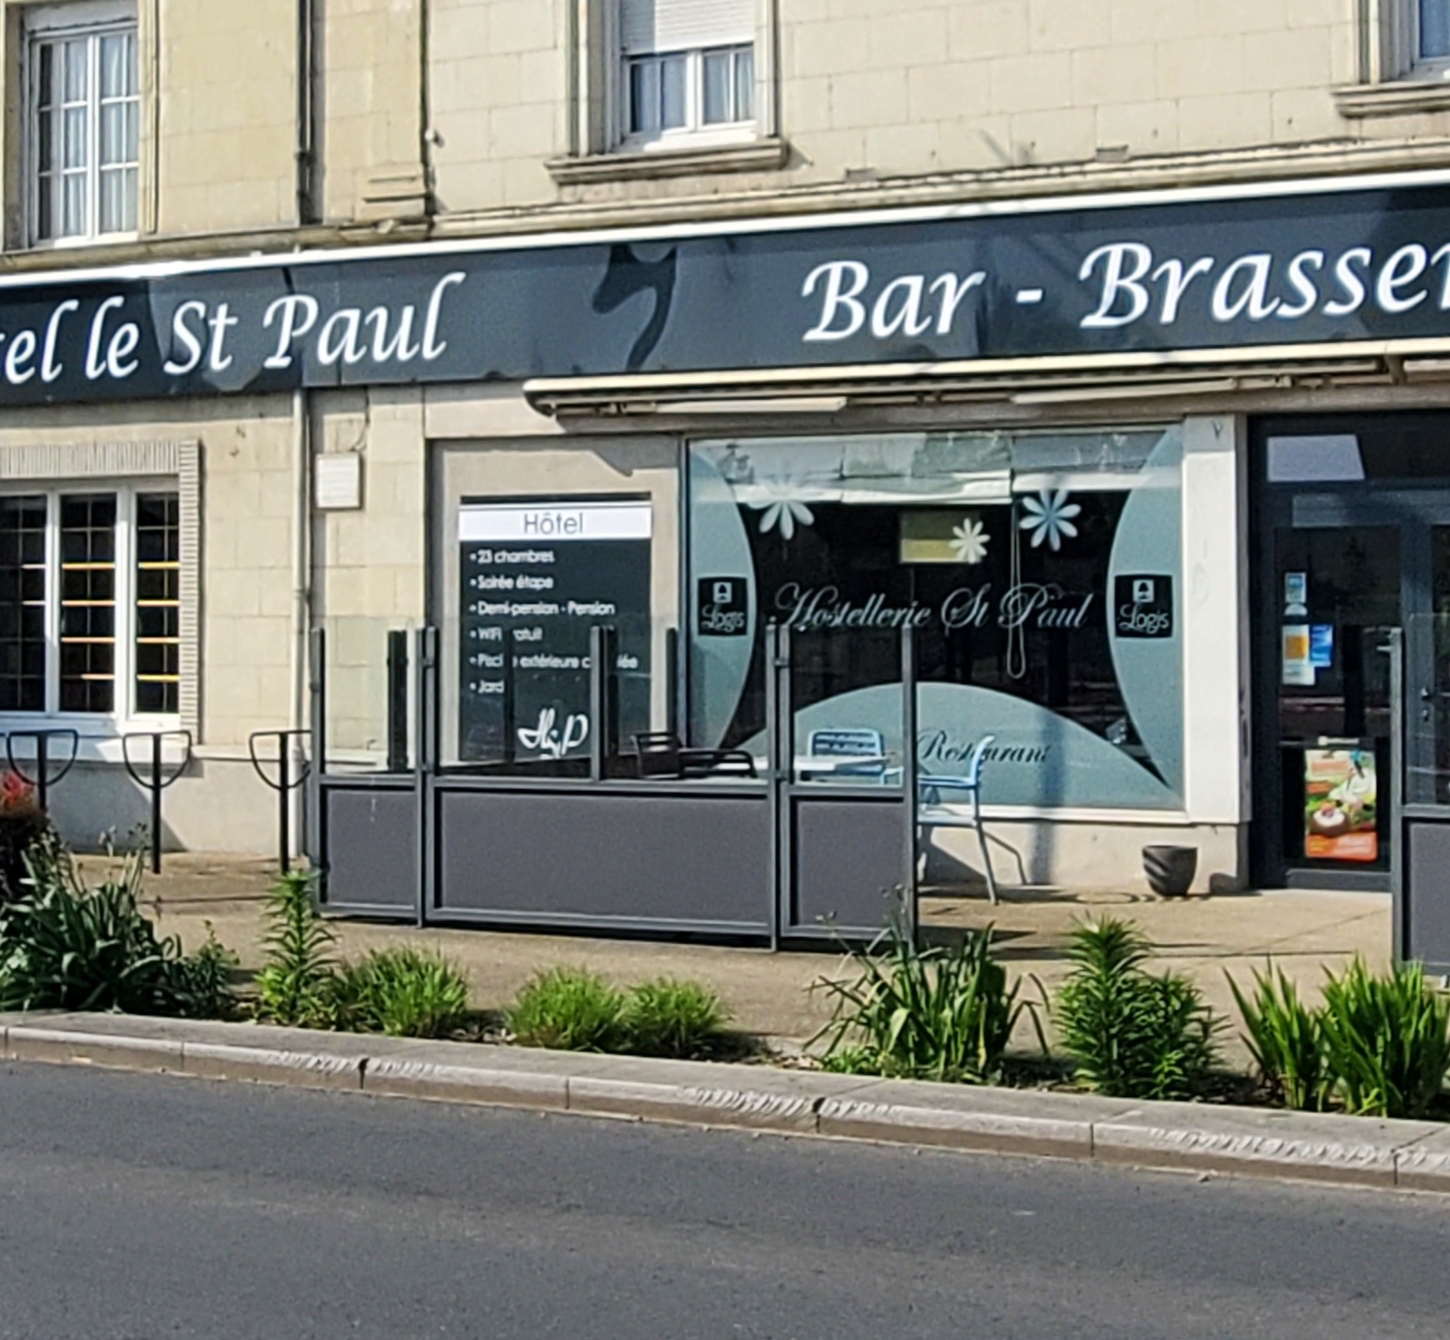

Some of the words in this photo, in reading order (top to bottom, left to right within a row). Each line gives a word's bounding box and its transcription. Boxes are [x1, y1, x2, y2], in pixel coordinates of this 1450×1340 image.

[802, 260, 987, 342] Bar
[85, 295, 140, 380] le
[163, 300, 238, 376] St
[261, 271, 466, 369] Paul
[523, 513, 584, 535] Hôtel
[774, 582, 933, 630] Hostellerie
[941, 583, 989, 629] St
[998, 582, 1094, 629] Paul
[1118, 602, 1169, 634] Logis
